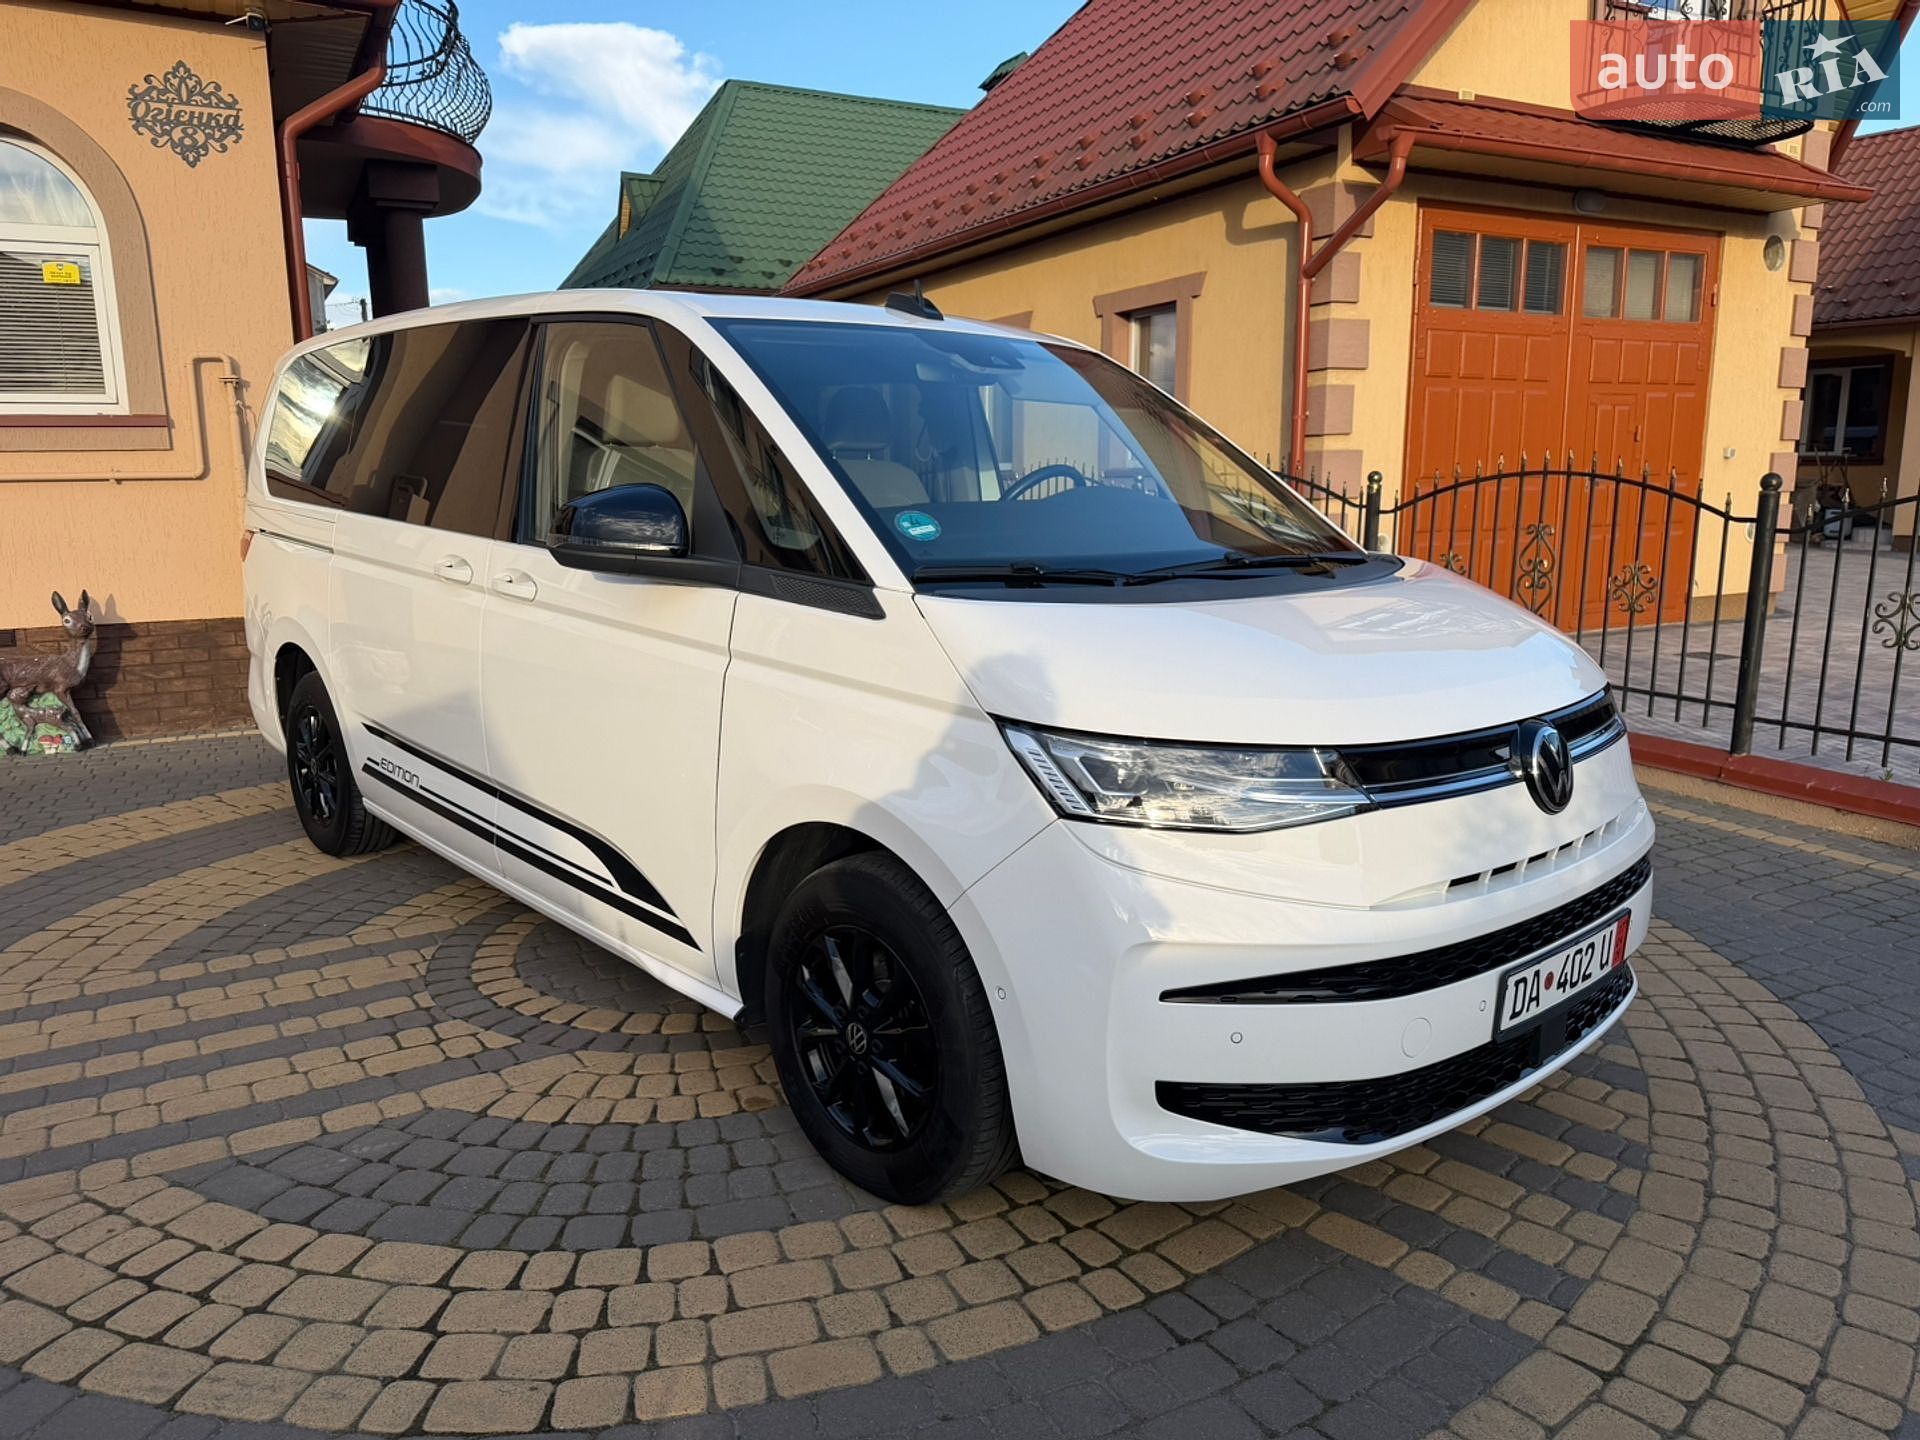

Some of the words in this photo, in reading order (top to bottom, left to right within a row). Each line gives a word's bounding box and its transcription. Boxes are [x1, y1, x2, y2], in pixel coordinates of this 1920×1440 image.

[178, 127, 199, 148] 8
[1509, 969, 1540, 1020] DA
[1556, 942, 1595, 993] 402
